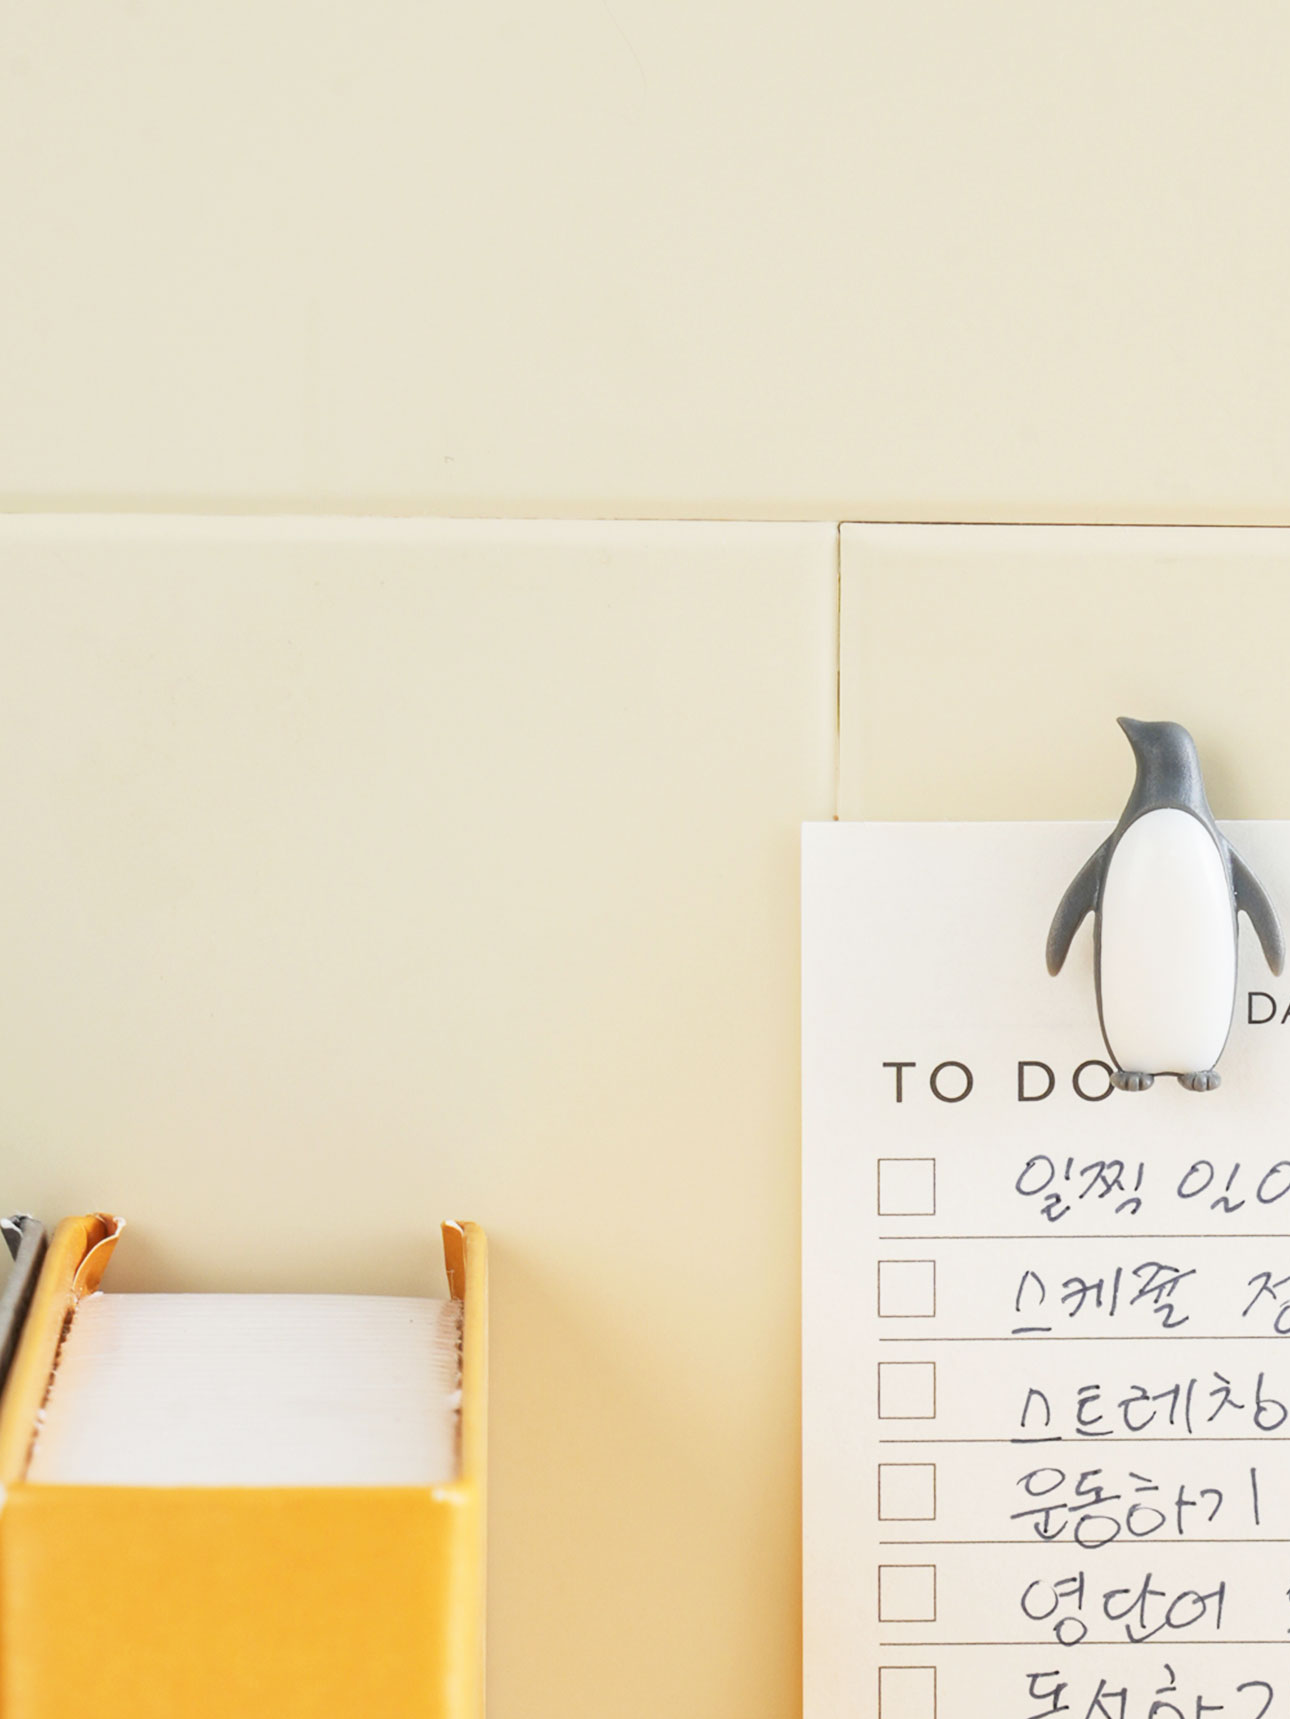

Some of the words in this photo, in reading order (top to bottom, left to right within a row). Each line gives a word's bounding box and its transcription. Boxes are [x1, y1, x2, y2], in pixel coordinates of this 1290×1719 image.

[882, 1060, 974, 1104] TO
[1017, 1059, 1116, 1102] DO
[1015, 1154, 1145, 1223] 일찍
[1011, 1261, 1197, 1334] 스케쥴
[1011, 1371, 1288, 1443] 스트레칭
[1010, 1467, 1260, 1548] 운동하기
[1020, 1570, 1226, 1646] 영단어
